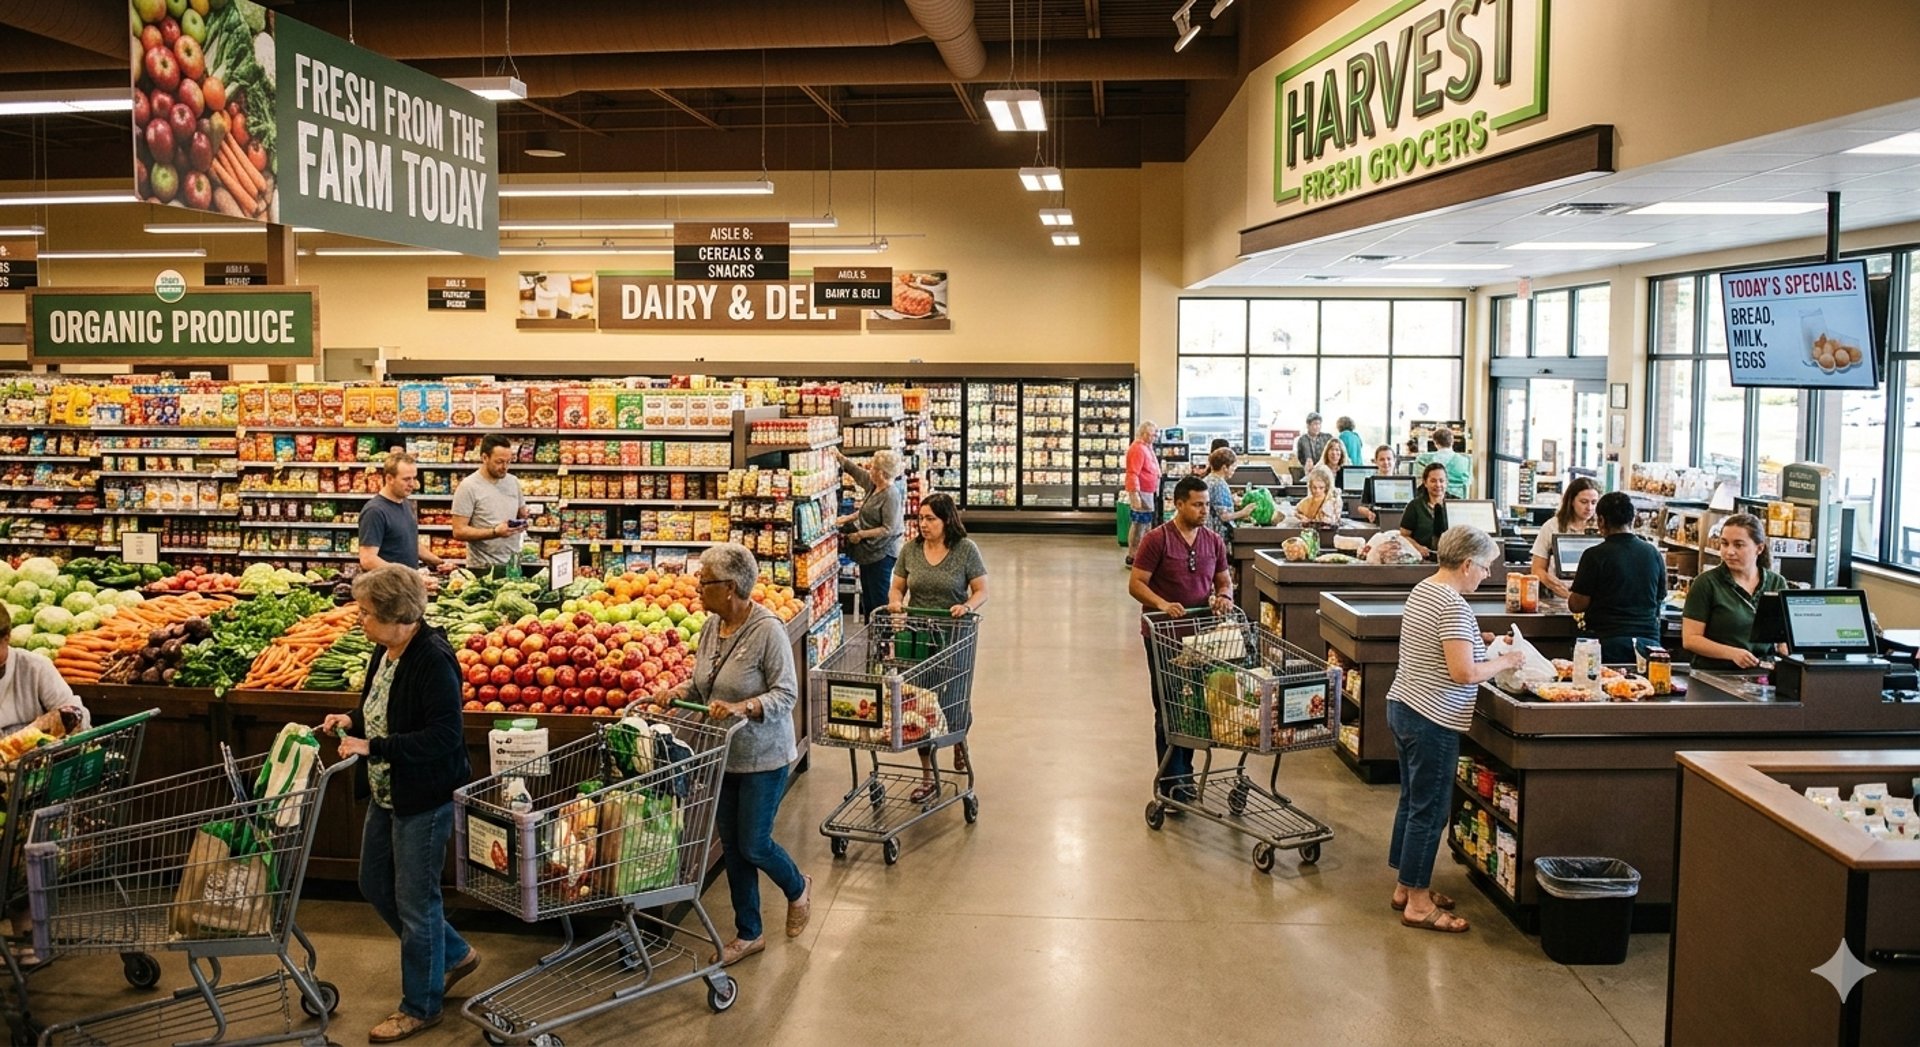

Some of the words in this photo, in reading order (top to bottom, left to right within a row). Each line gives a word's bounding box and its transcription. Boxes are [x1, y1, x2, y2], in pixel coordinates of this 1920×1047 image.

[1287, 0, 1513, 169] HARVEST
[295, 53, 376, 131] FRESH
[384, 85, 444, 152] FROM
[449, 108, 486, 164] THE
[1302, 153, 1362, 205] FRESH
[1368, 110, 1488, 184] GROCERS
[298, 120, 393, 213] FARM
[402, 150, 487, 231] TODAY
[710, 227, 740, 241] AISLE
[742, 227, 754, 241] 8:
[698, 246, 751, 261] CEREALS
[754, 246, 764, 261] &
[1728, 276, 1781, 298] TODAY'S
[1785, 270, 1857, 294] SPECIALS:
[621, 284, 718, 320] DAIRY
[727, 284, 755, 321] &
[1731, 306, 1775, 326] BREAD,
[50, 310, 163, 344] ORGANIC
[172, 310, 295, 344] PRODUCE
[1733, 329, 1768, 348] MILK,
[1735, 351, 1766, 369] EGGS
